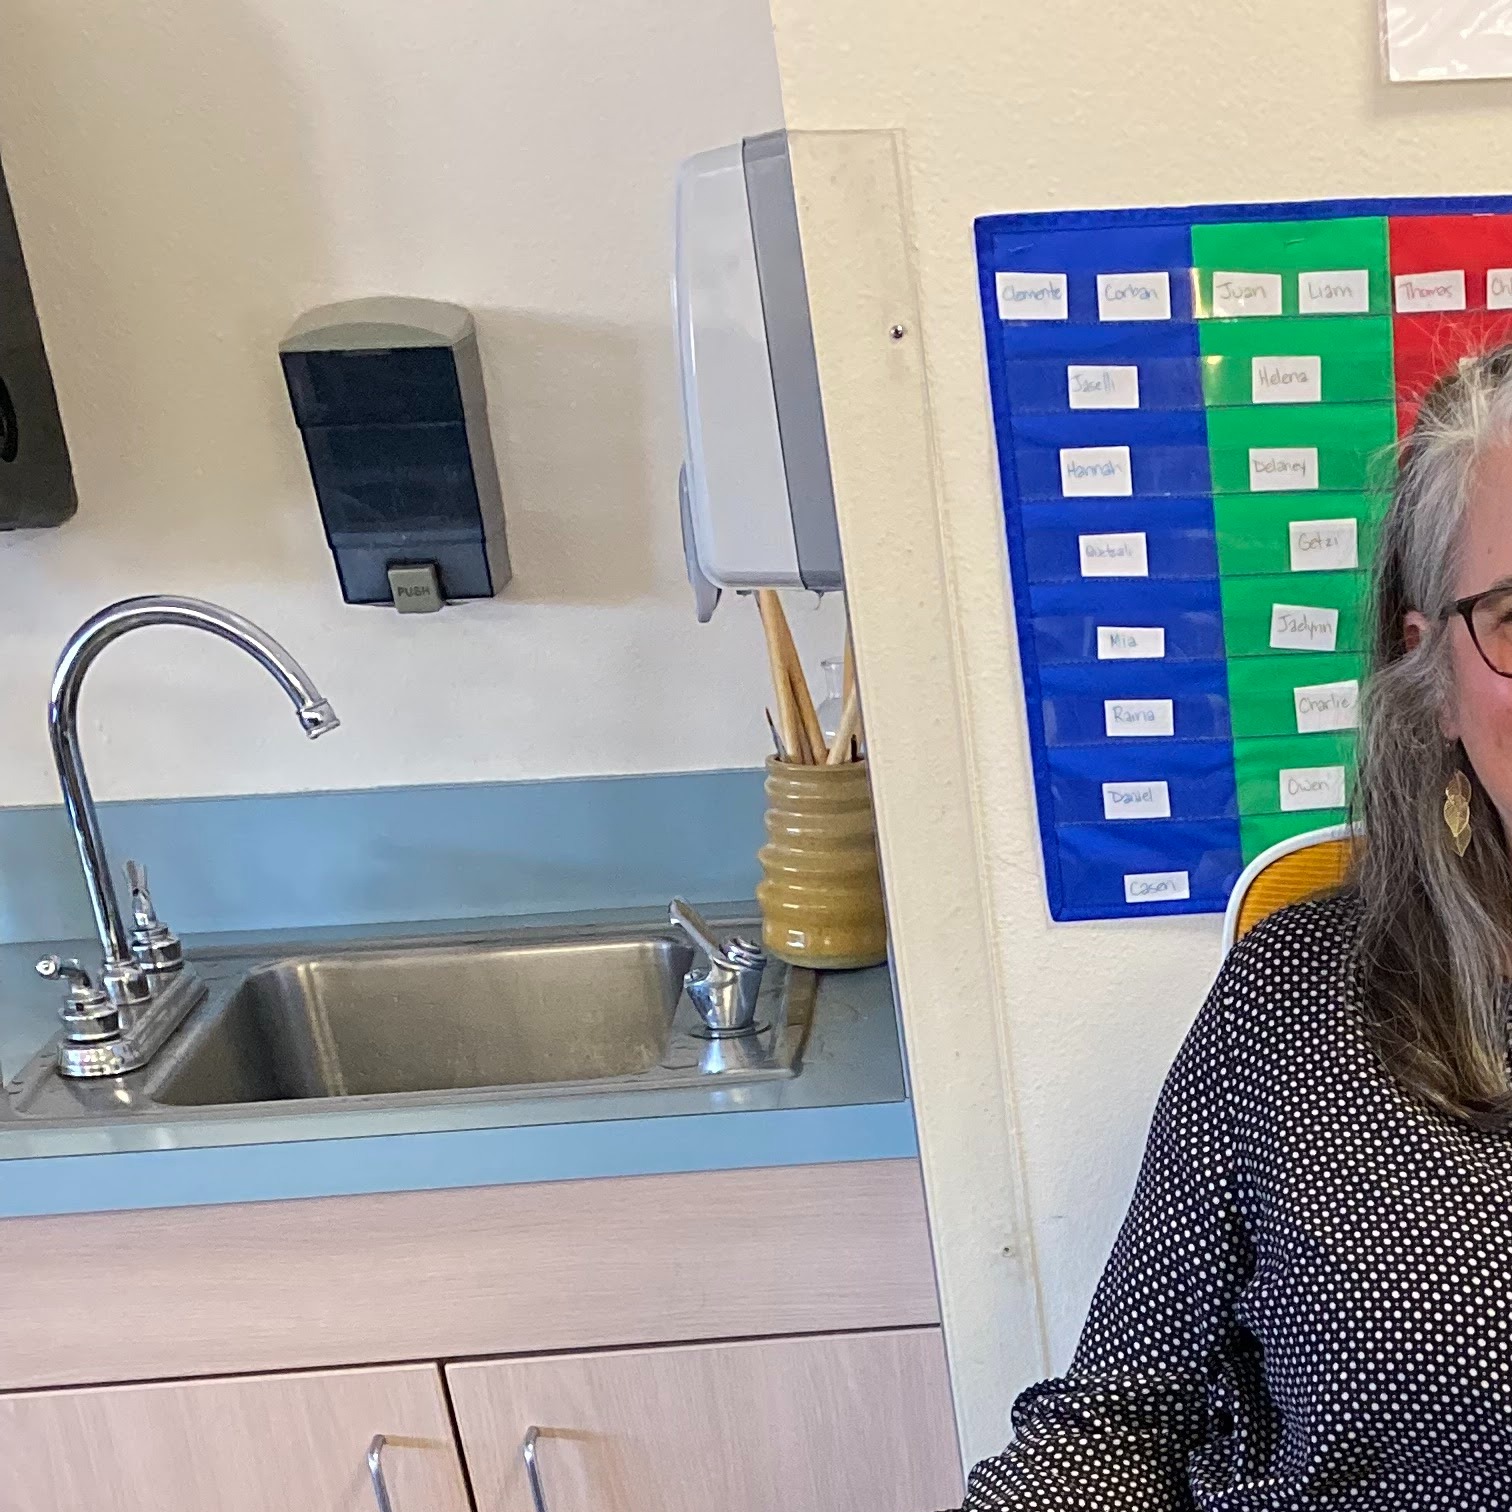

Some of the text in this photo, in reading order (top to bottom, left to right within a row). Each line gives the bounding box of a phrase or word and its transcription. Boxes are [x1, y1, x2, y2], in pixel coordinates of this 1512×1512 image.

[1216, 281, 1267, 300] Juan
[1308, 282, 1353, 299] Liam
[1258, 366, 1309, 388] Helena
[1252, 458, 1306, 477] Delaney
[397, 586, 431, 598] PUSH
[1110, 633, 1138, 649] Mia
[1107, 786, 1153, 804] Daniel
[1288, 778, 1329, 795] Owen
